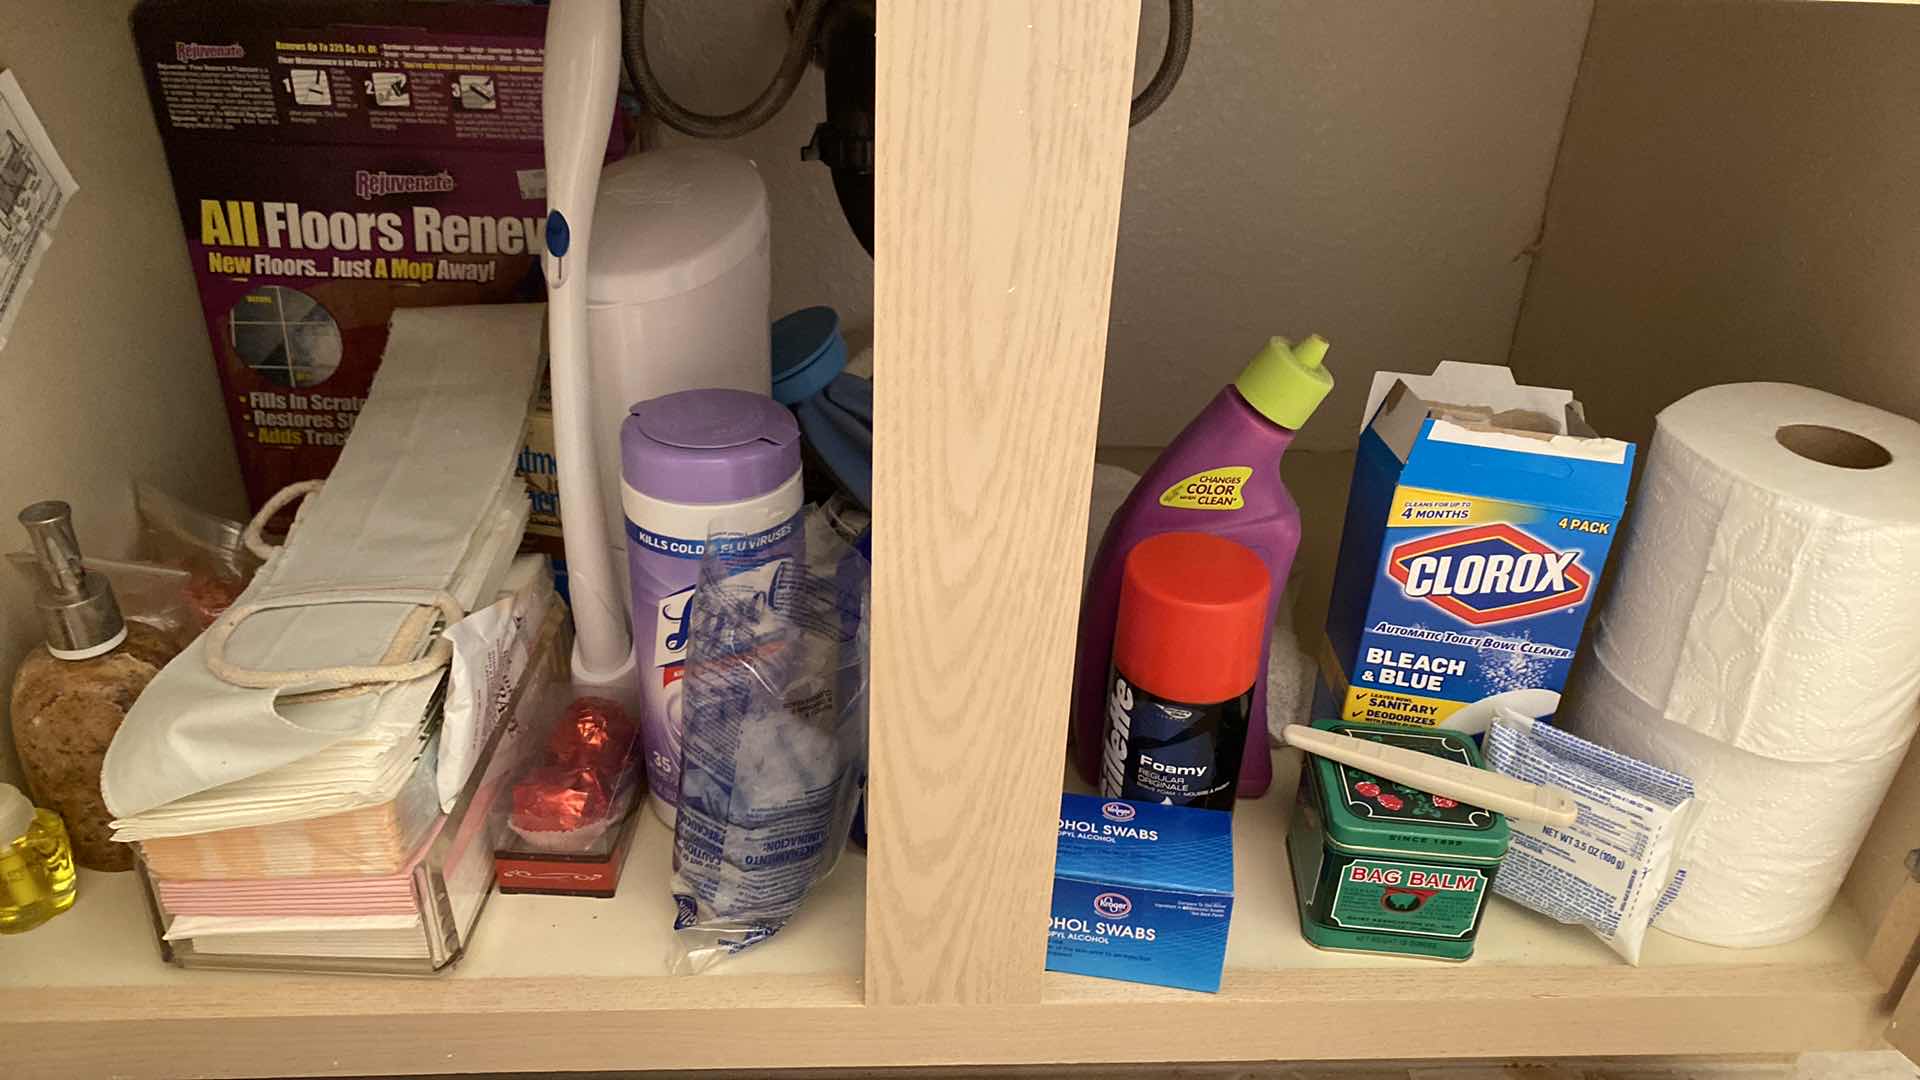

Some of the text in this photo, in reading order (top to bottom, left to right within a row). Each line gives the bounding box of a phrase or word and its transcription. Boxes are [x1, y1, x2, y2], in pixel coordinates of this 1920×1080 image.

[282, 78, 292, 93] 1
[364, 80, 375, 95] 2
[451, 83, 461, 98] 3
[356, 170, 455, 199] Rejuvenate
[201, 199, 260, 248] All
[263, 202, 405, 252] Floors
[209, 252, 251, 274] New
[331, 257, 372, 280] Just
[374, 258, 386, 278] A
[390, 258, 433, 282] Mop
[436, 259, 496, 282] Away!
[249, 392, 287, 409] Fills
[311, 394, 366, 411] Scrat
[254, 410, 334, 428] Restores
[258, 427, 348, 446] Adds Trac
[1199, 475, 1241, 484] CHANGES
[1187, 483, 1235, 496] COLOR
[1401, 507, 1469, 519] 4 MONTHS
[1558, 518, 1610, 534] 4 PACK
[639, 531, 668, 551] KILLS
[670, 542, 705, 555] COLD
[719, 541, 746, 554] FLU
[748, 525, 793, 549] VIRUSES
[1405, 551, 1580, 597] CLOROX
[1375, 622, 1570, 658] AUTOMATIC TOILET BOWL CLEANER
[1366, 647, 1466, 676] BLEACH
[1362, 668, 1444, 692] & BLUE
[1369, 698, 1438, 715] SANITARY
[1367, 709, 1436, 726] DEODORIZES
[1140, 754, 1207, 776] Foamy
[1137, 774, 1190, 792] ORIGINALE
[1138, 767, 1185, 784] REGULAR
[1077, 832, 1116, 843] ALCOHOL
[1103, 825, 1159, 841] SWABS
[1389, 834, 1428, 844] SINCE
[1542, 825, 1625, 870] NET WT 3.5 OZ (100 g)
[1349, 866, 1478, 892] BAG BALM
[1099, 896, 1127, 913] Kroger
[1067, 933, 1109, 944] ALCOHOL
[1095, 922, 1156, 941] SWABS
